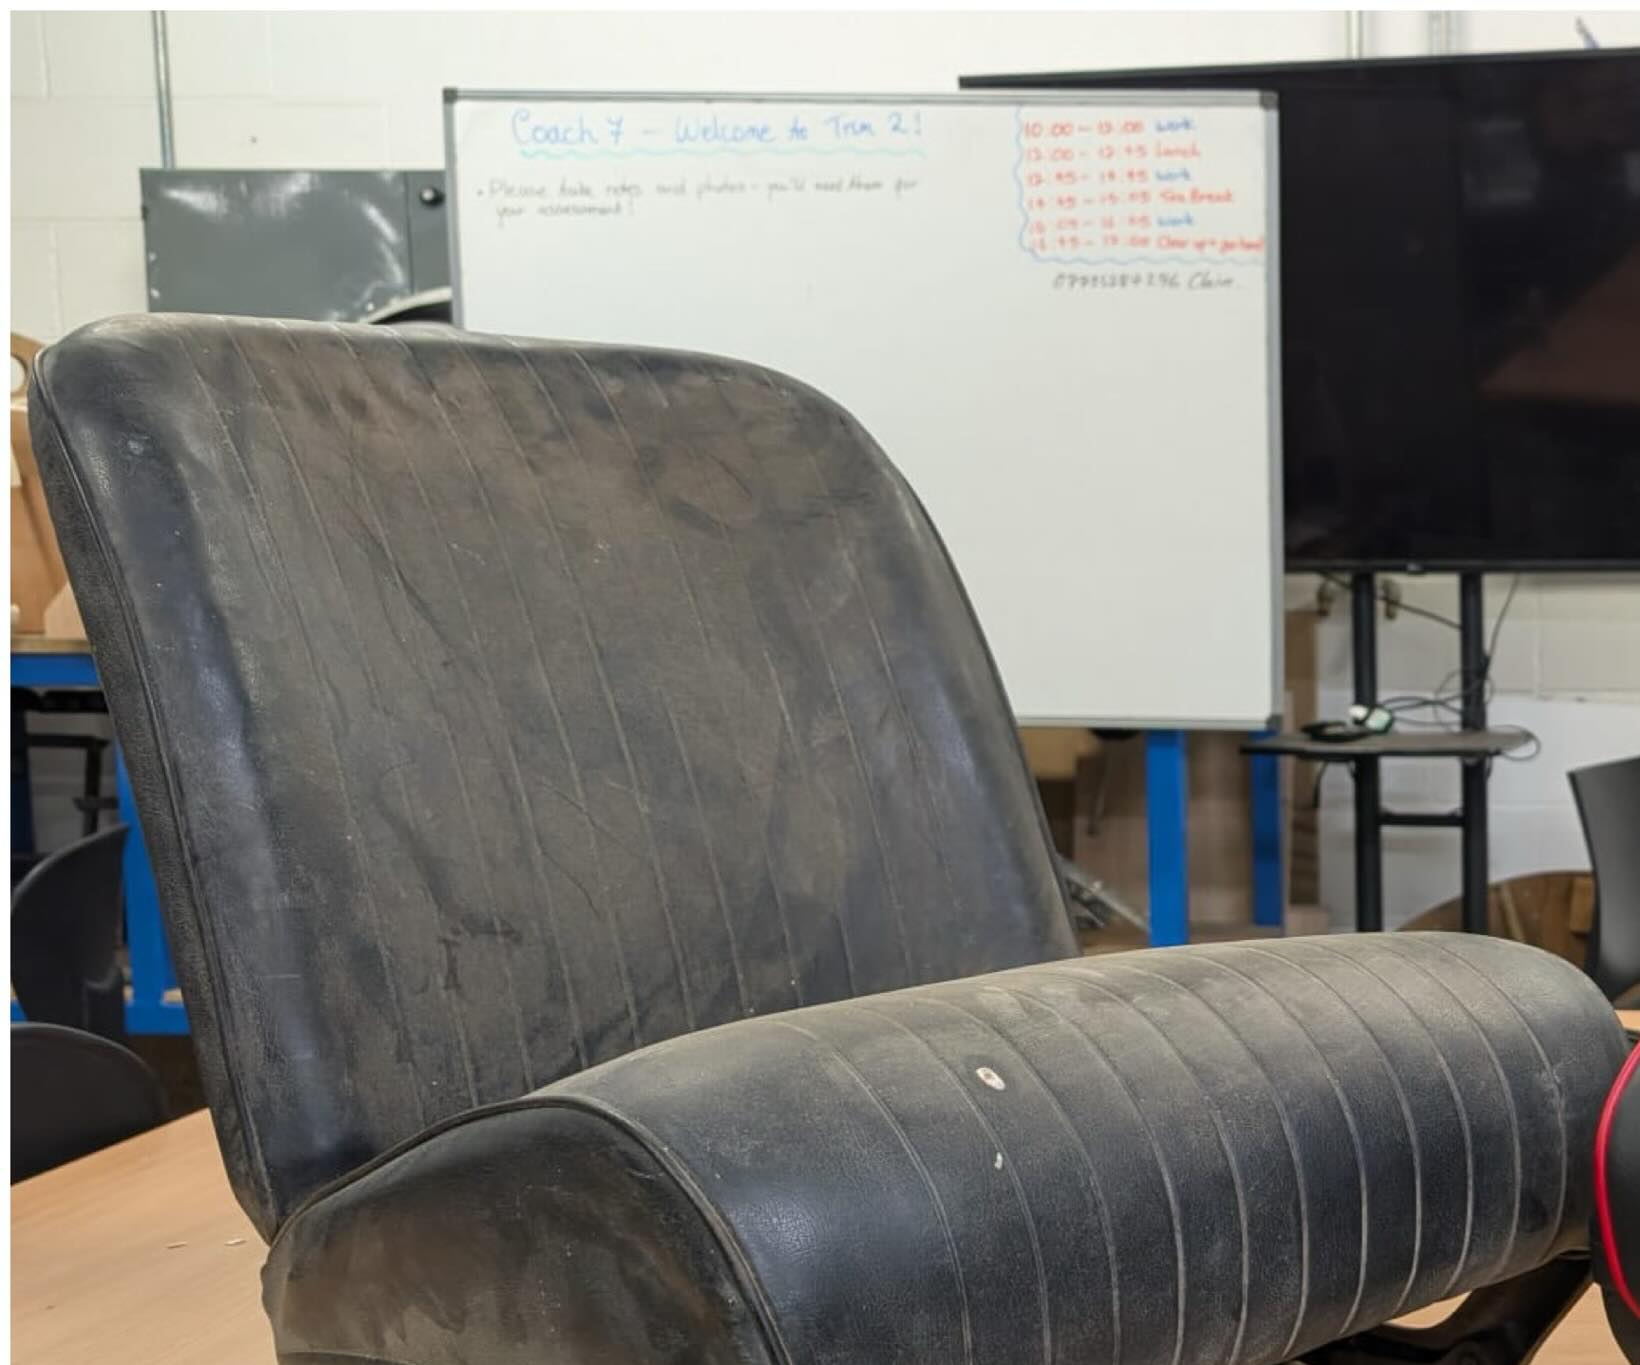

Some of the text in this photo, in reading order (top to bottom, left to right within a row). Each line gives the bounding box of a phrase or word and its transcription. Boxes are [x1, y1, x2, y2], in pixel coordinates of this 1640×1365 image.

[511, 108, 600, 146] Coach
[606, 115, 625, 146] 7
[674, 113, 777, 144] Welcome
[788, 116, 810, 141] to
